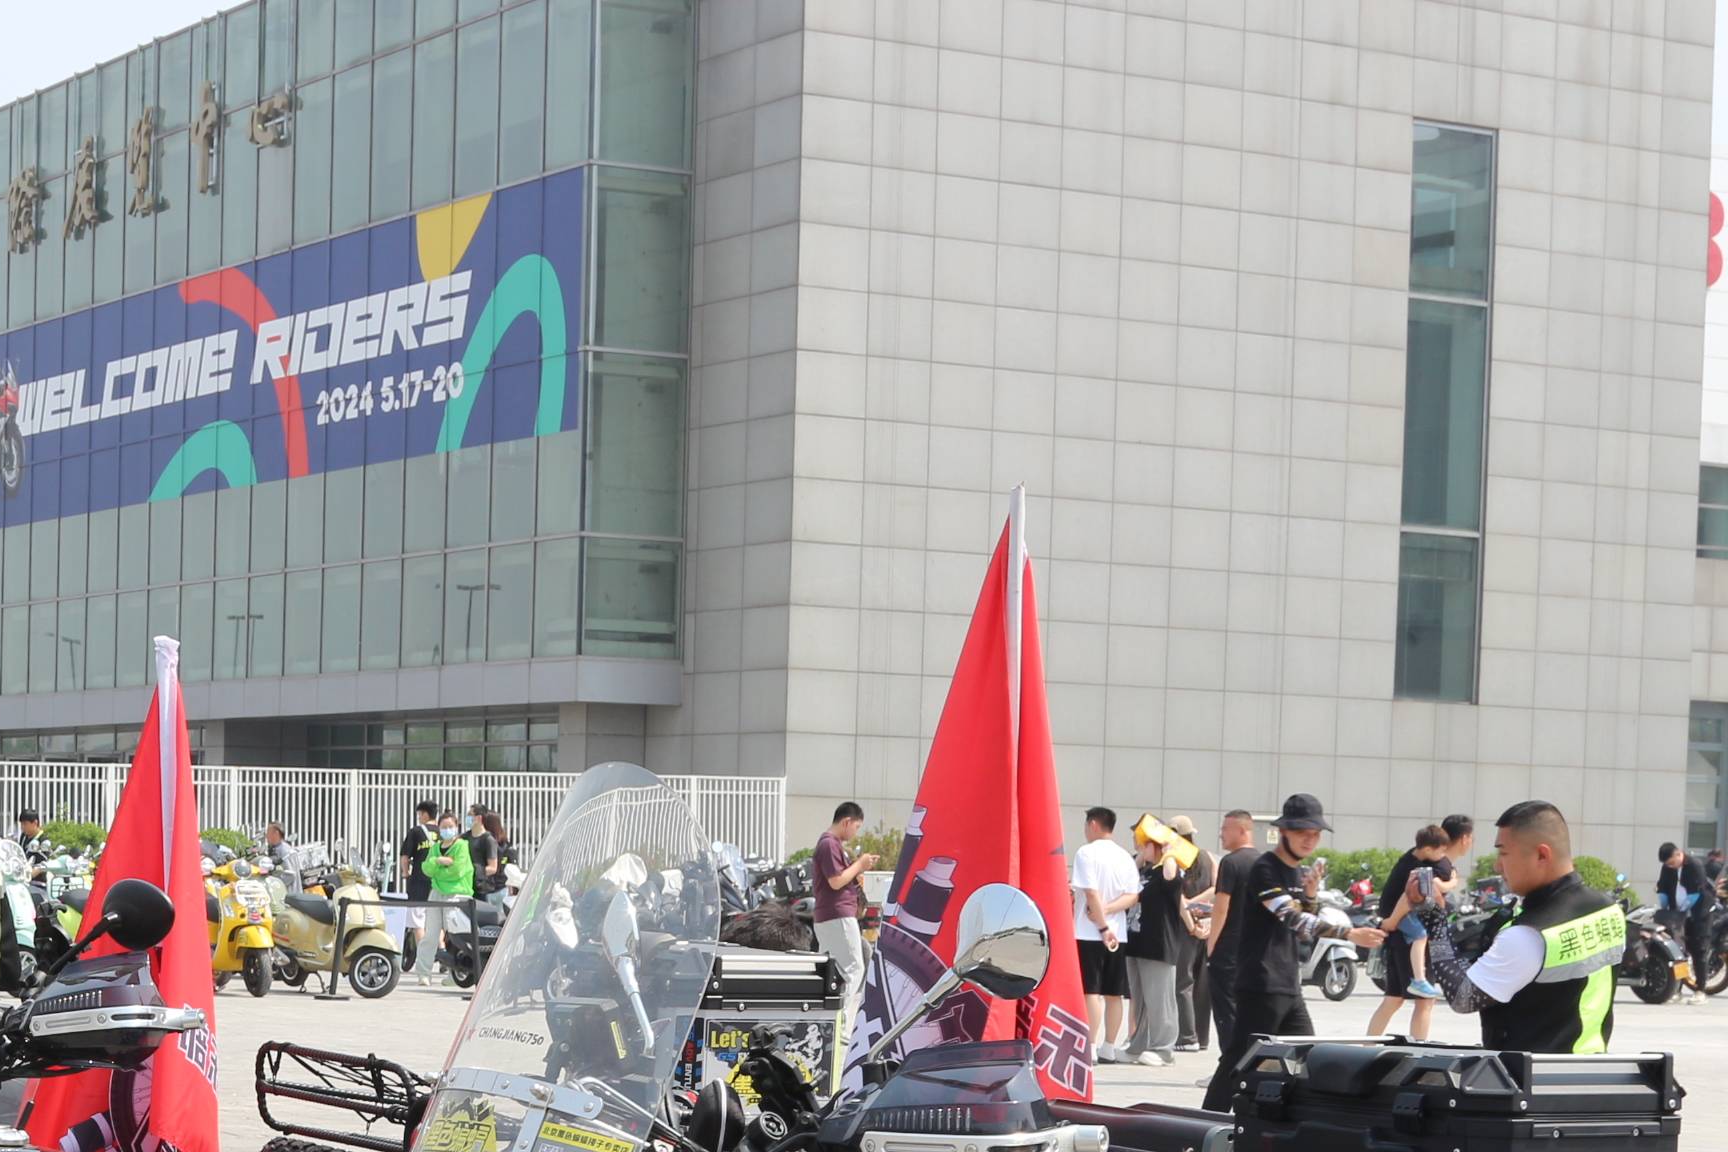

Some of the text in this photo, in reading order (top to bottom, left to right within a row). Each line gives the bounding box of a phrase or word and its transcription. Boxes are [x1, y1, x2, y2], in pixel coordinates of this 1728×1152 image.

[15, 269, 472, 437] WELCOME RIDERS
[316, 384, 374, 426] 2024
